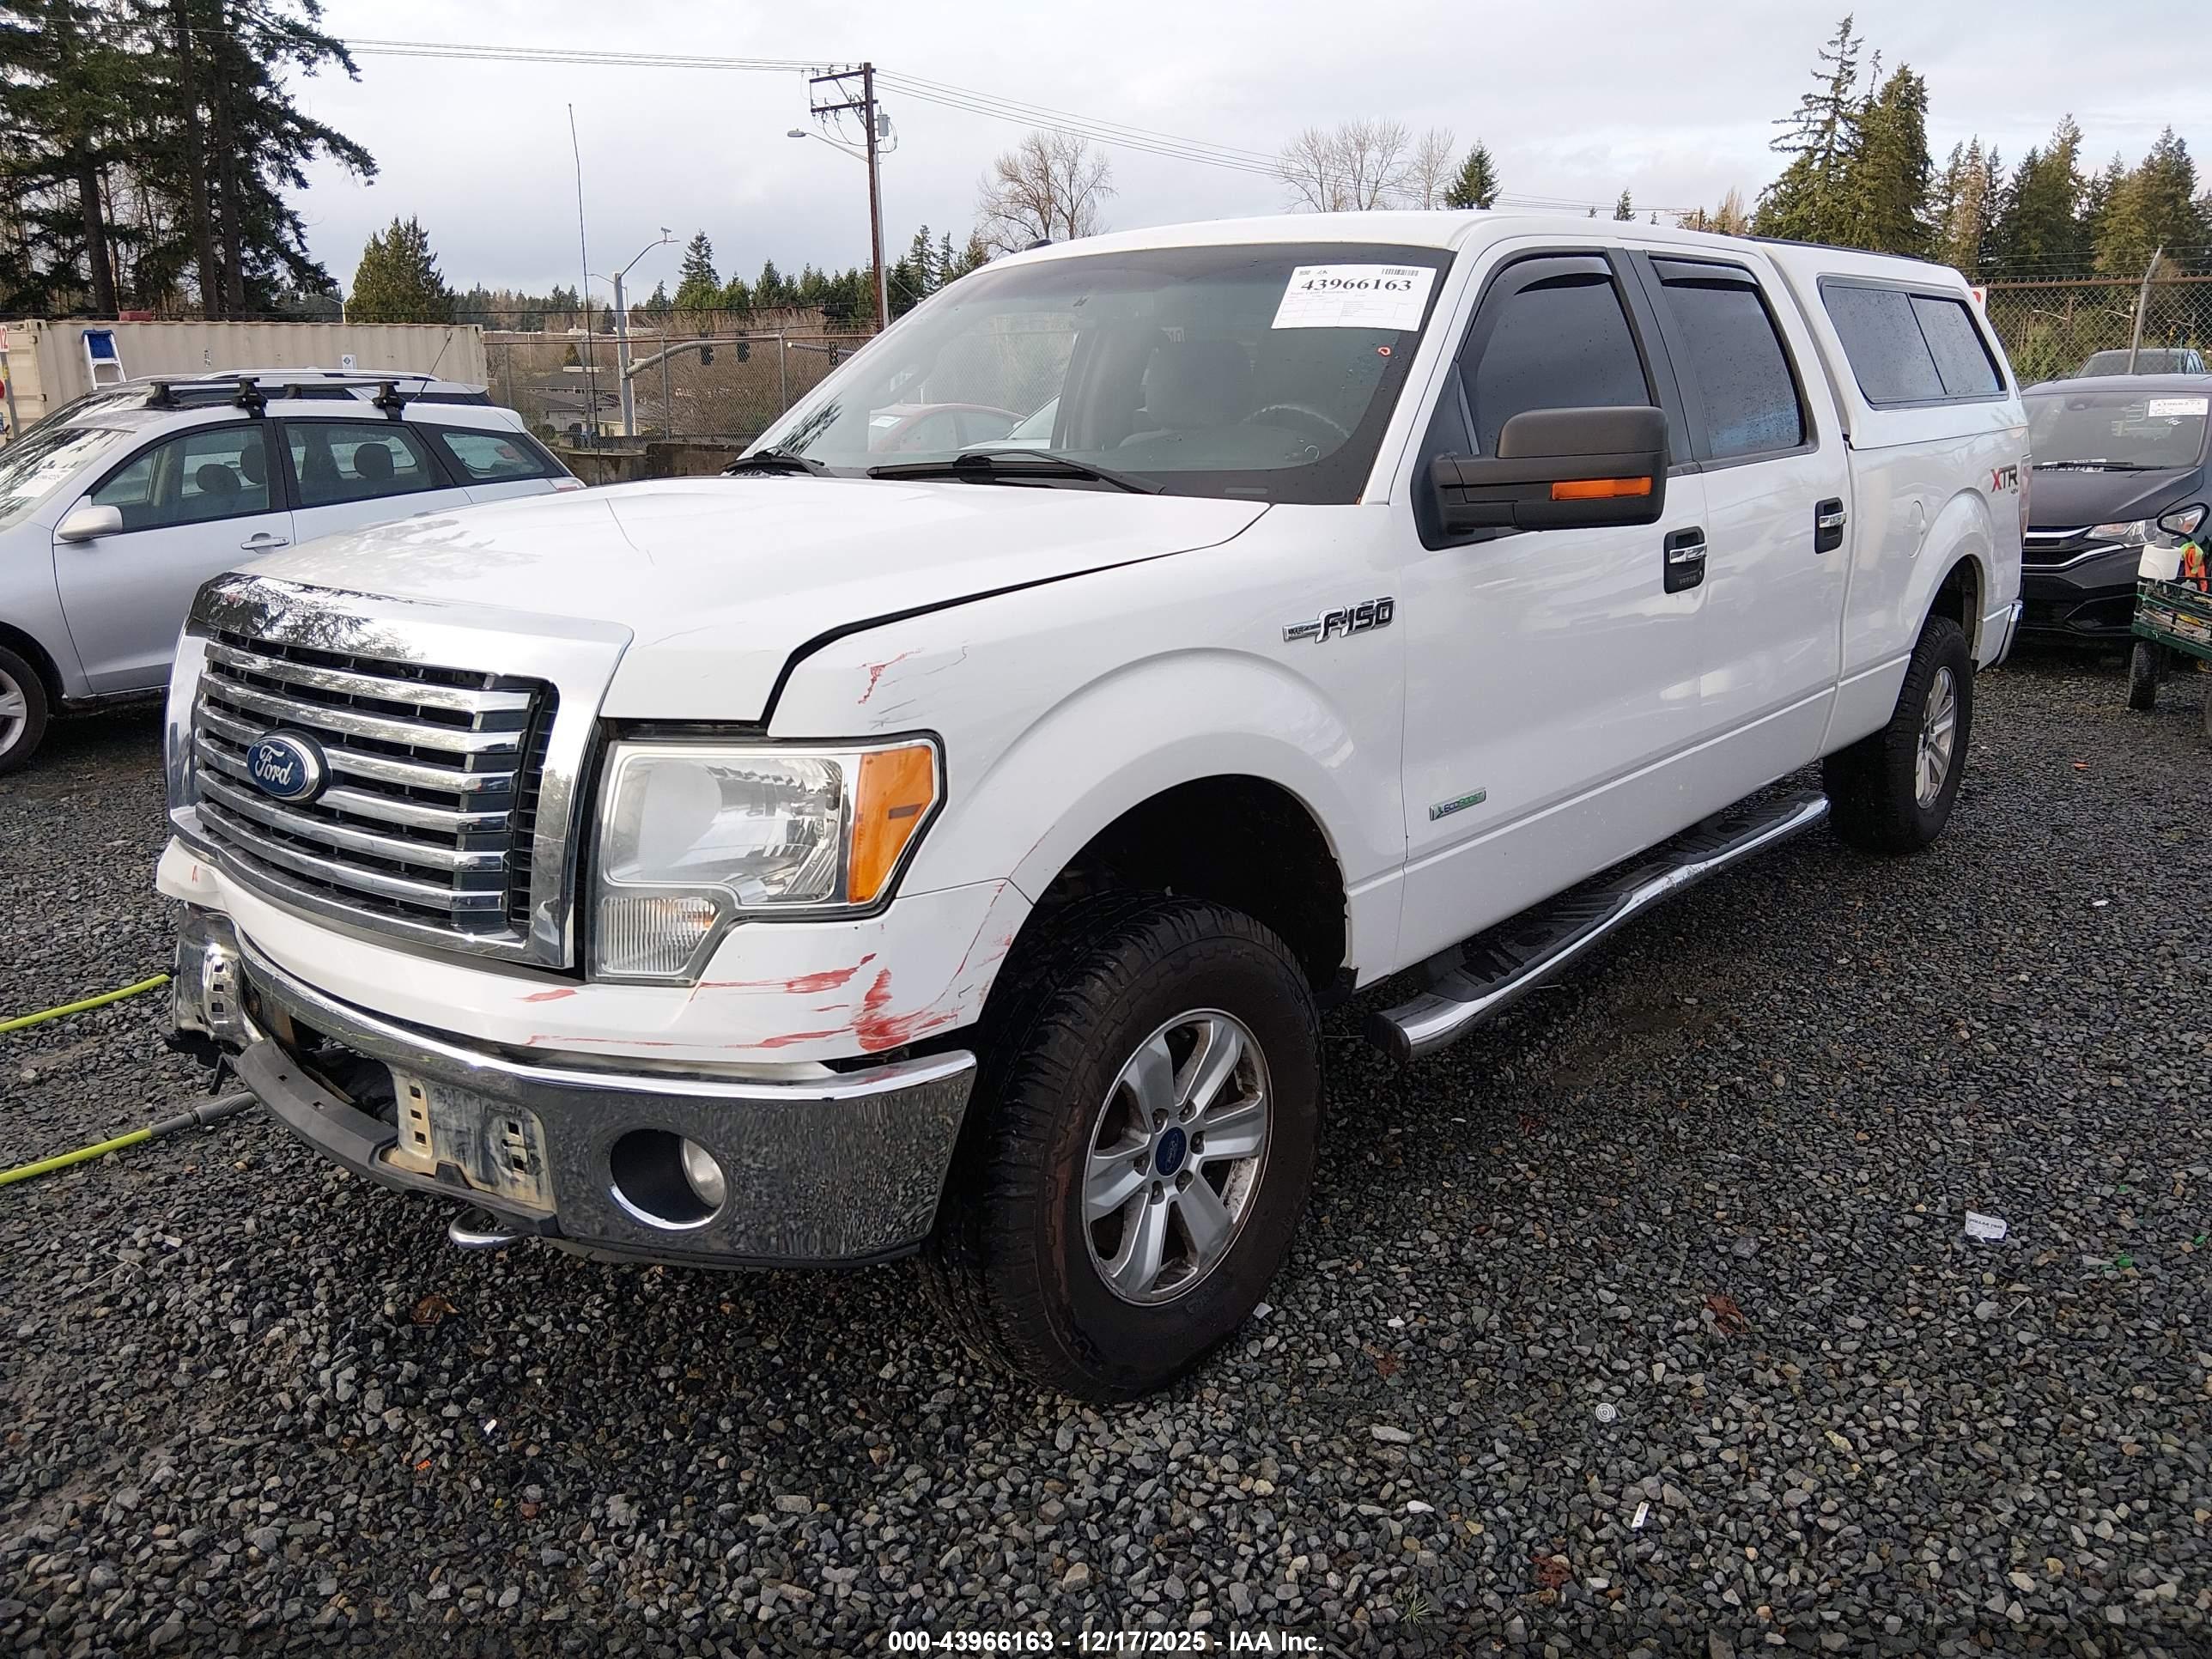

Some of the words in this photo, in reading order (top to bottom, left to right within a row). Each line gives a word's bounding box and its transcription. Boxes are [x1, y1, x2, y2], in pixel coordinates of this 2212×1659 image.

[1301, 278, 1412, 291] 43966163
[1991, 464, 2018, 493] XTR
[255, 744, 294, 786] Ford
